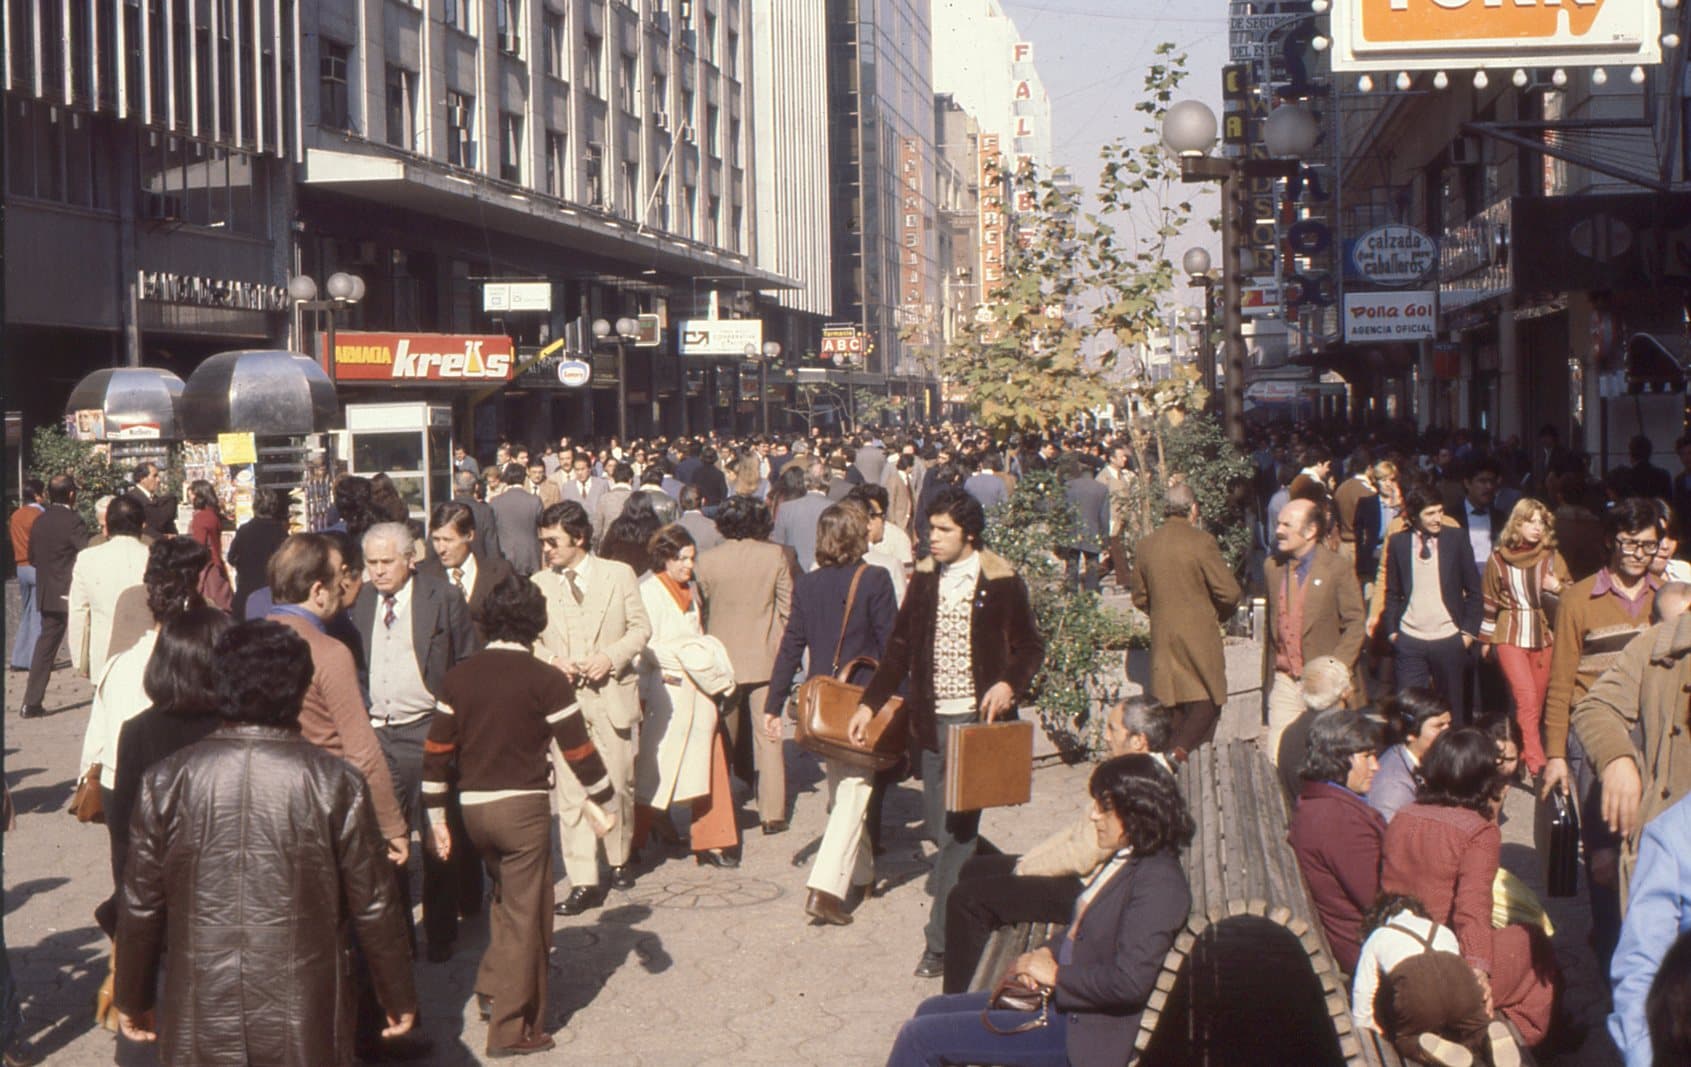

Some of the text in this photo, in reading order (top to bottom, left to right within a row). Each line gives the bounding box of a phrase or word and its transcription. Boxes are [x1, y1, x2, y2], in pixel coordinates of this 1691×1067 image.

[1231, 46, 1248, 57] DEL
[1404, 303, 1433, 318] Gol
[1351, 323, 1433, 335] AGENCIA OFICIAL
[336, 345, 392, 363] ARMACIA
